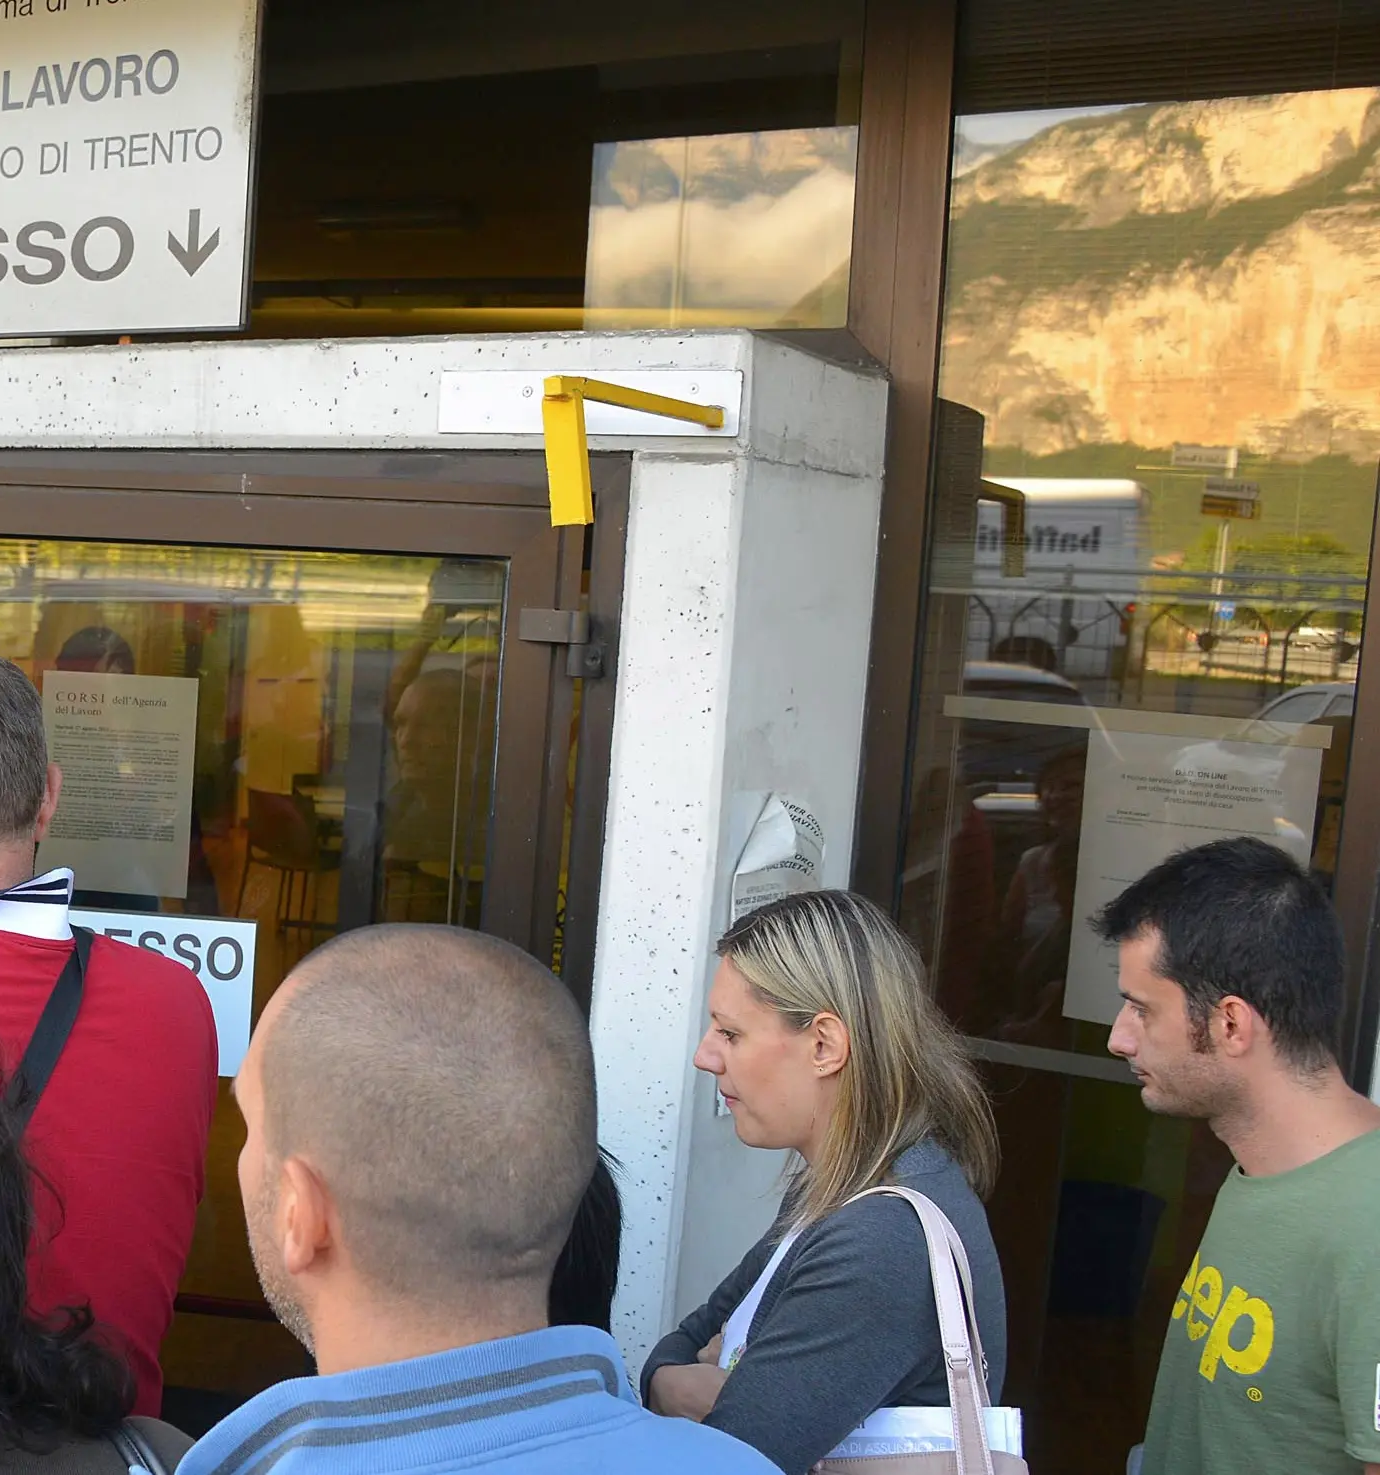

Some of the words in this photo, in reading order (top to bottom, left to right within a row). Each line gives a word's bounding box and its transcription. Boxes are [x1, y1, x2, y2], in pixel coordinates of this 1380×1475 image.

[0, 49, 180, 111] LAVORO
[40, 140, 69, 173] DI
[83, 126, 223, 170] TRENTO
[788, 804, 806, 816] PER
